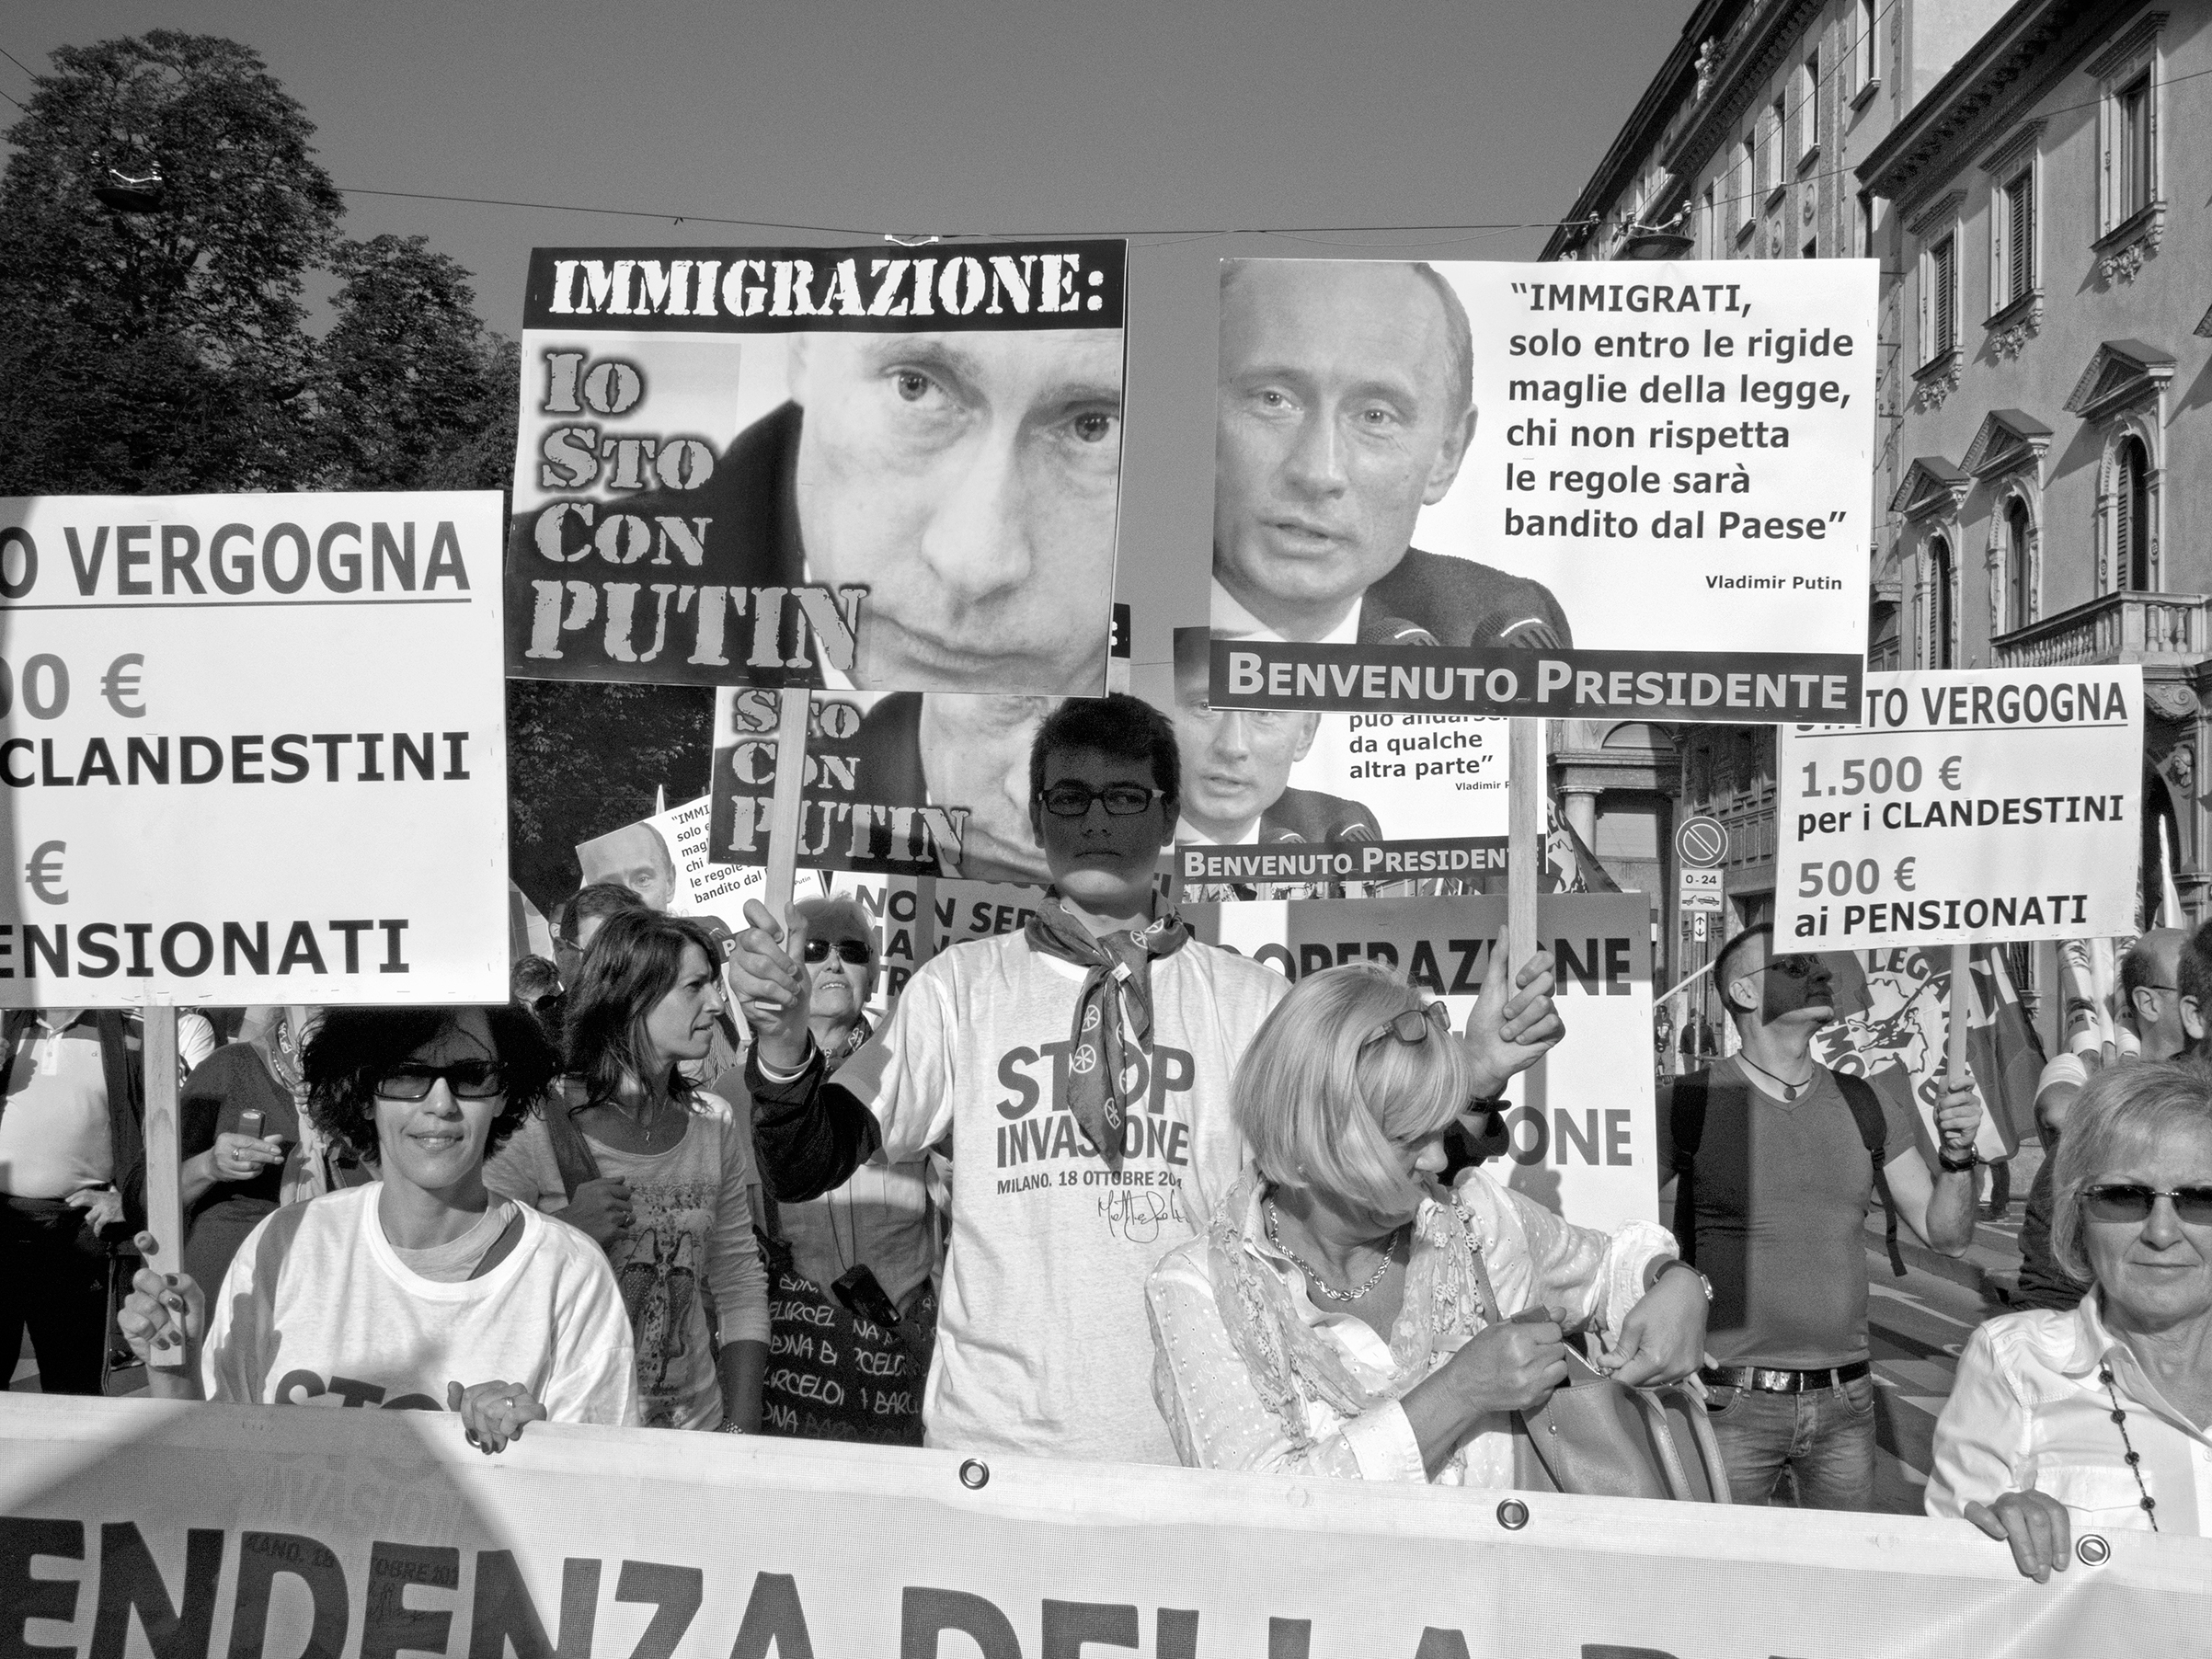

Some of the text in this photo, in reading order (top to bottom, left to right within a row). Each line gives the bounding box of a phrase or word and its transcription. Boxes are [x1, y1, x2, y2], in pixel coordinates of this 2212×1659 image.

[548, 254, 1104, 317] IMMIGRAZIONE:
[1510, 328, 1852, 363] solo entro le rigide
[1509, 374, 1850, 409] maglie della legge,
[1507, 418, 1788, 454] chi non rispetta
[1507, 463, 1749, 499] le regole sarà
[1506, 508, 1637, 538] bandito
[1652, 510, 1703, 538] dal
[63, 521, 471, 597] VERGOGNA
[1706, 576, 1841, 589] Vladimir Putin
[524, 579, 870, 670] PUTIN
[99, 653, 147, 718] €
[1229, 651, 1848, 709] BENVENUTO PRESIDENTE
[1920, 681, 2128, 727] VERGOGNA
[0, 731, 471, 788] CLANDESTINI
[1350, 731, 1482, 755] da qualche
[1350, 761, 1405, 778] altra
[1456, 782, 1501, 790] Vladimir
[1801, 755, 1964, 798] 1.500 €
[677, 826, 701, 841] solo
[1797, 795, 2124, 842] per i CLANDESTINI
[24, 840, 70, 905] €
[686, 857, 704, 873] chi
[690, 864, 743, 887] le regole
[1184, 846, 1507, 877] BENVENUTO PRESIDEN
[1798, 855, 1917, 898] 500 €
[694, 880, 740, 904] bandito
[744, 871, 762, 886] dal
[1701, 874, 1717, 886] 24
[855, 885, 1037, 934] NON SER
[1794, 894, 2089, 937] ai PENSIONATI
[1059, 1172, 1078, 1185] 18
[1083, 1172, 1154, 1185] OTTOBRE
